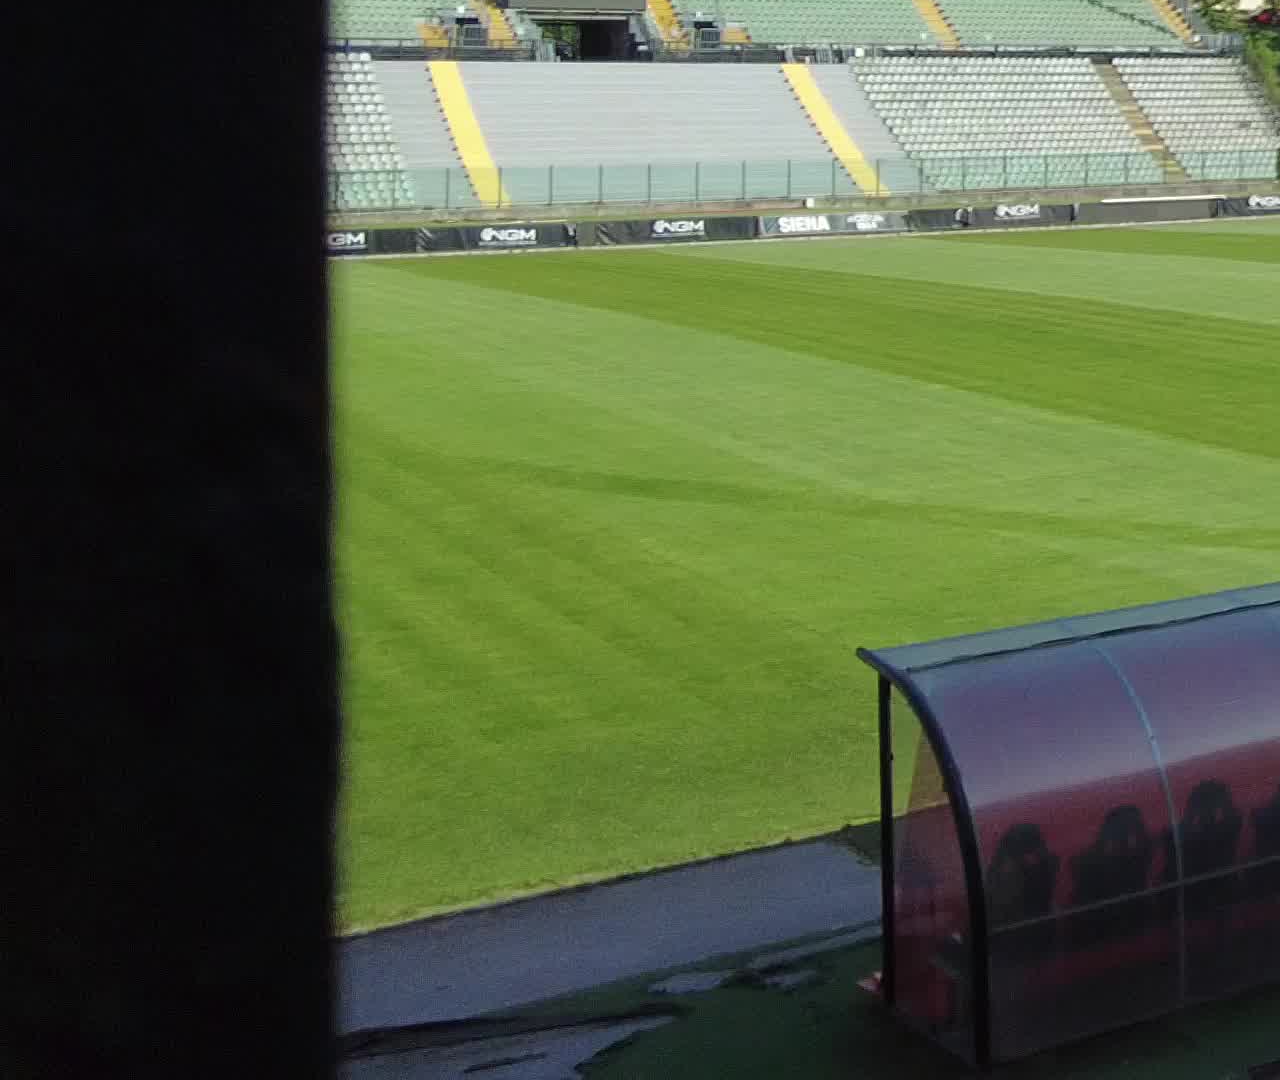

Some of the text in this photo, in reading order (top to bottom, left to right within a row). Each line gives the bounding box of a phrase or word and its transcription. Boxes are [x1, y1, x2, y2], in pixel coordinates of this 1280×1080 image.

[656, 219, 705, 233] NGM
[778, 215, 830, 233] SIENA
[327, 230, 366, 246] GM
[484, 227, 537, 242] NGM
